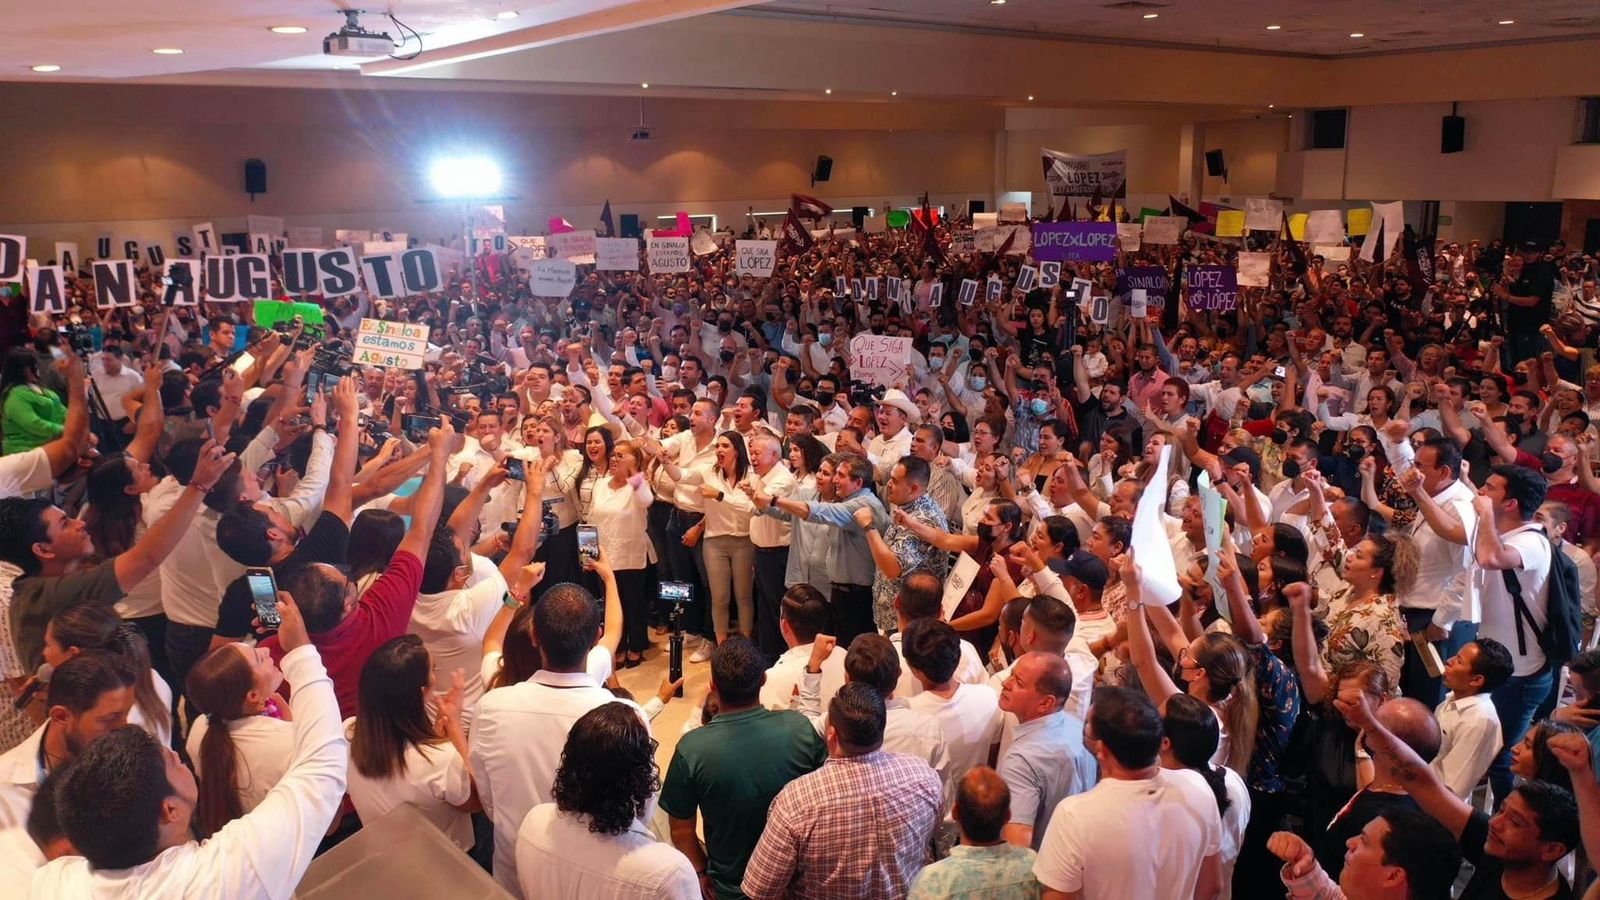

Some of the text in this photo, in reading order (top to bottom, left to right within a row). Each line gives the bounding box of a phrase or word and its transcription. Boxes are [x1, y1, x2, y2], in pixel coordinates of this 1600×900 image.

[652, 258, 687, 268] AGUSTO
[362, 335, 416, 351] estamos
[359, 350, 407, 367] Agusto
